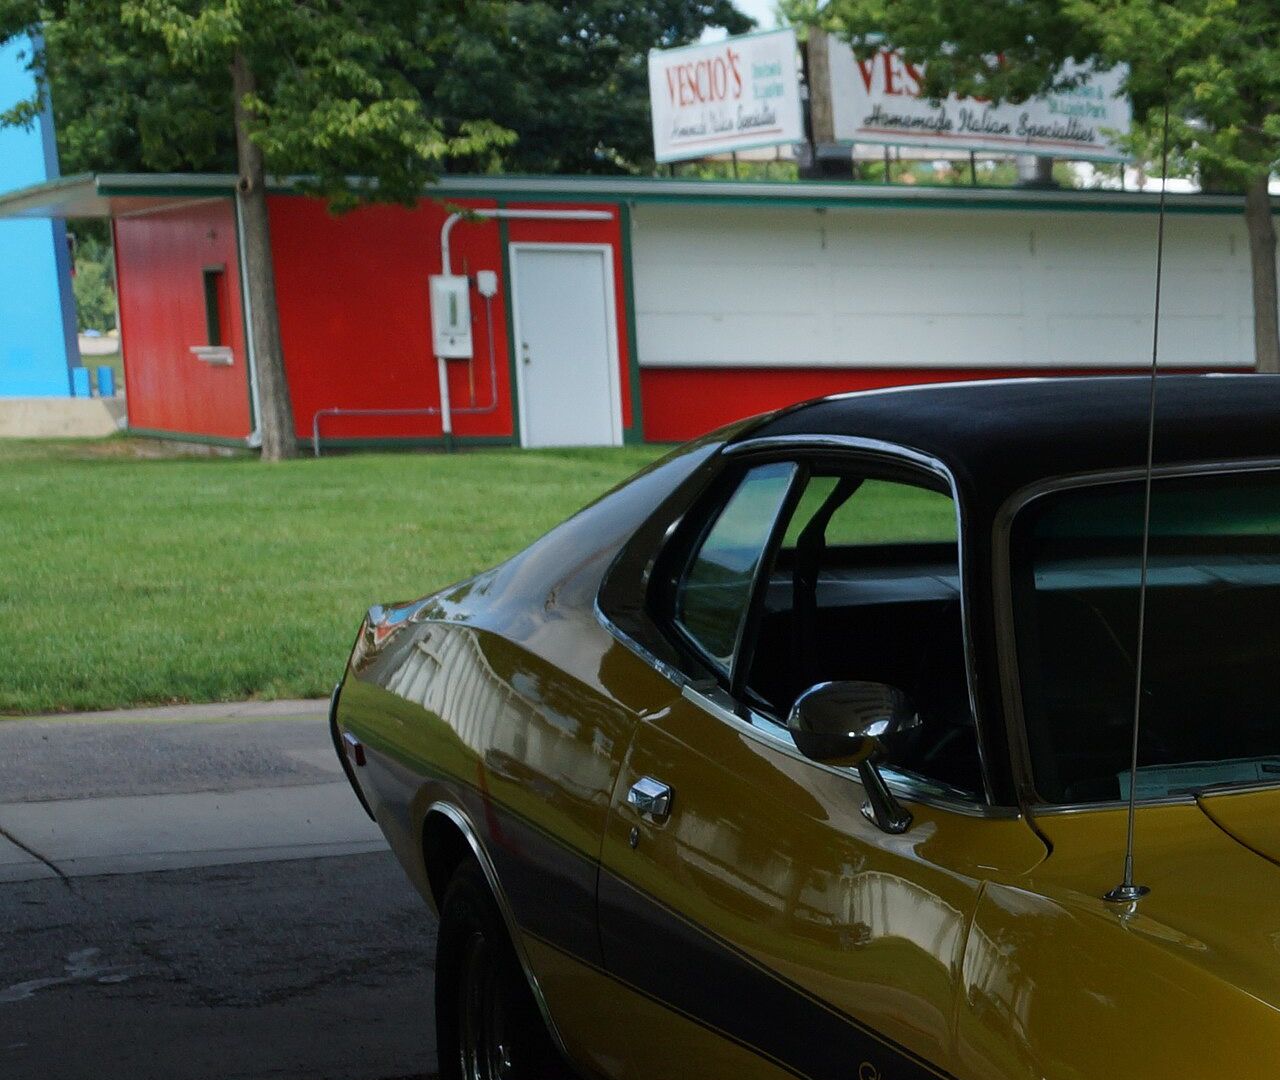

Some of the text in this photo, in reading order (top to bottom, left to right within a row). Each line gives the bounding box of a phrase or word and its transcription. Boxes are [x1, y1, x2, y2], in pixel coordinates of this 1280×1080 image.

[665, 47, 741, 107] VESCIO'S
[864, 104, 1095, 145] Homemade Italian Specialties
